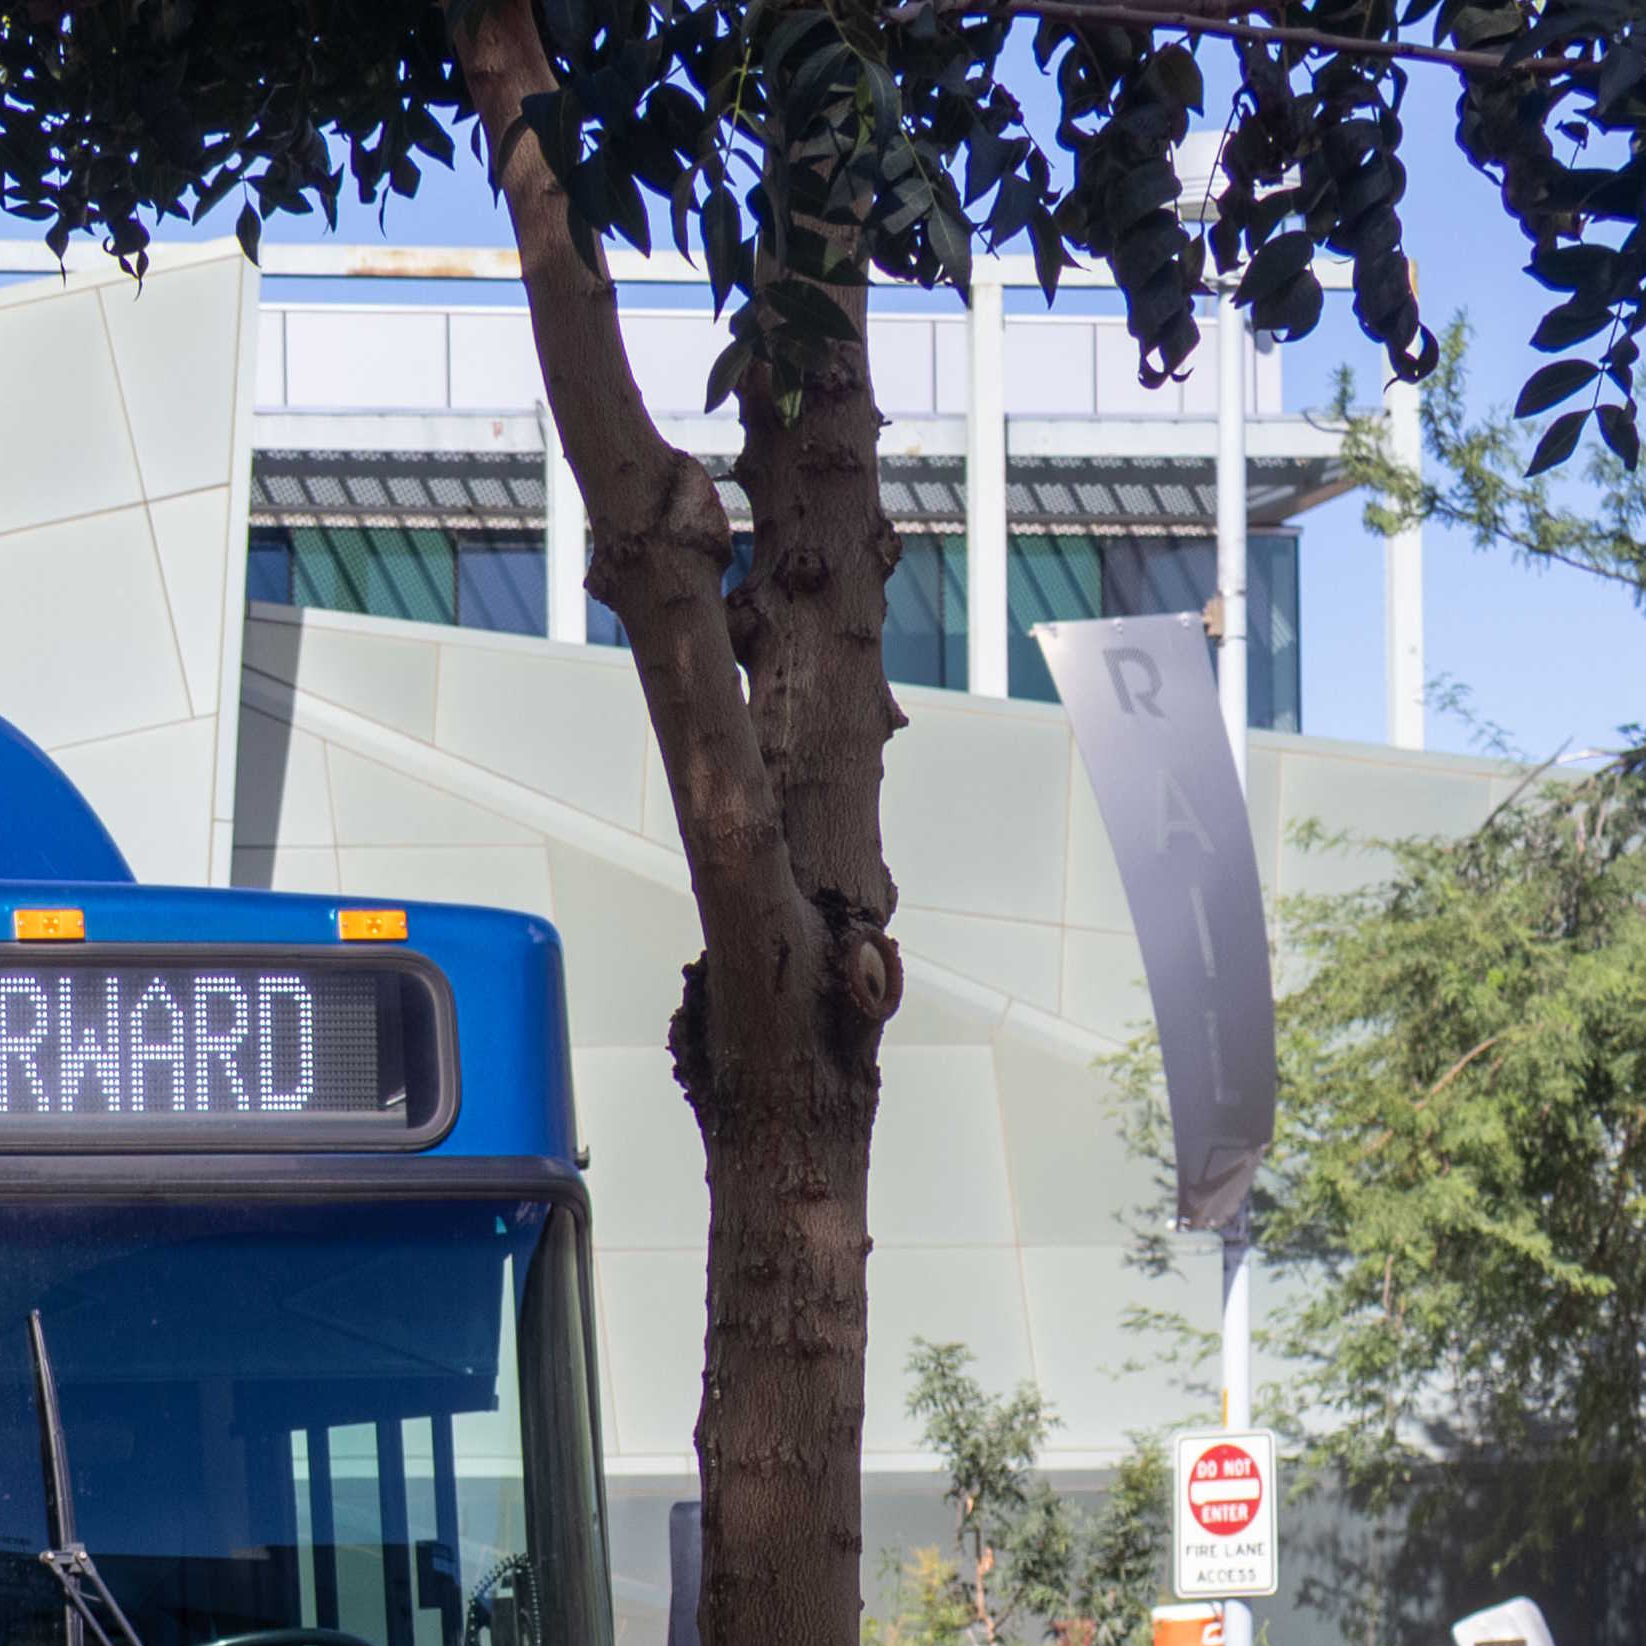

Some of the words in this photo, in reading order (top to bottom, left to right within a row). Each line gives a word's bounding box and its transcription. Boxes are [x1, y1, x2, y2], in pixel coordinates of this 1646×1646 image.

[1196, 1459, 1218, 1479] DO
[1223, 1457, 1253, 1477] NOT
[1201, 1503, 1249, 1524] ENTER
[1185, 1543, 1218, 1559] FIRE
[1225, 1541, 1266, 1558] LANE
[1196, 1567, 1257, 1584] ACCESS
